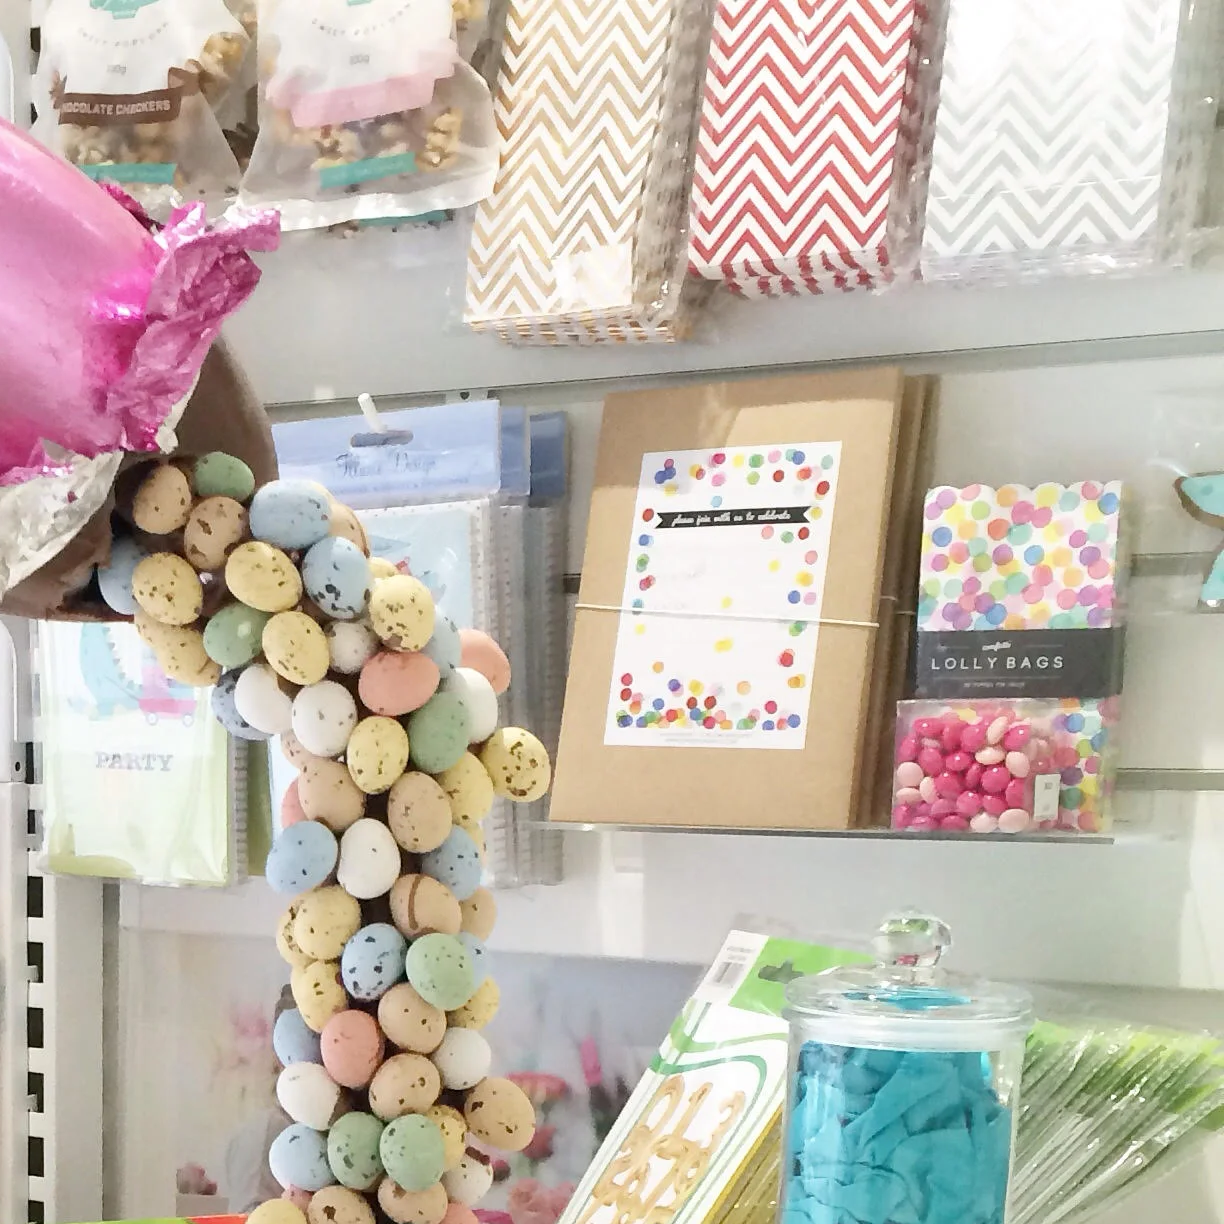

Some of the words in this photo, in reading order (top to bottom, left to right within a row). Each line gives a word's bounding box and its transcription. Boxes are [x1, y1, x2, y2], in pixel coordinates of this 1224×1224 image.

[61, 102, 114, 115] HOCOLATE
[116, 100, 171, 113] CHECKERS
[931, 657, 998, 670] LOLLY
[1006, 655, 1064, 669] BAGS
[95, 751, 174, 772] PARTY
